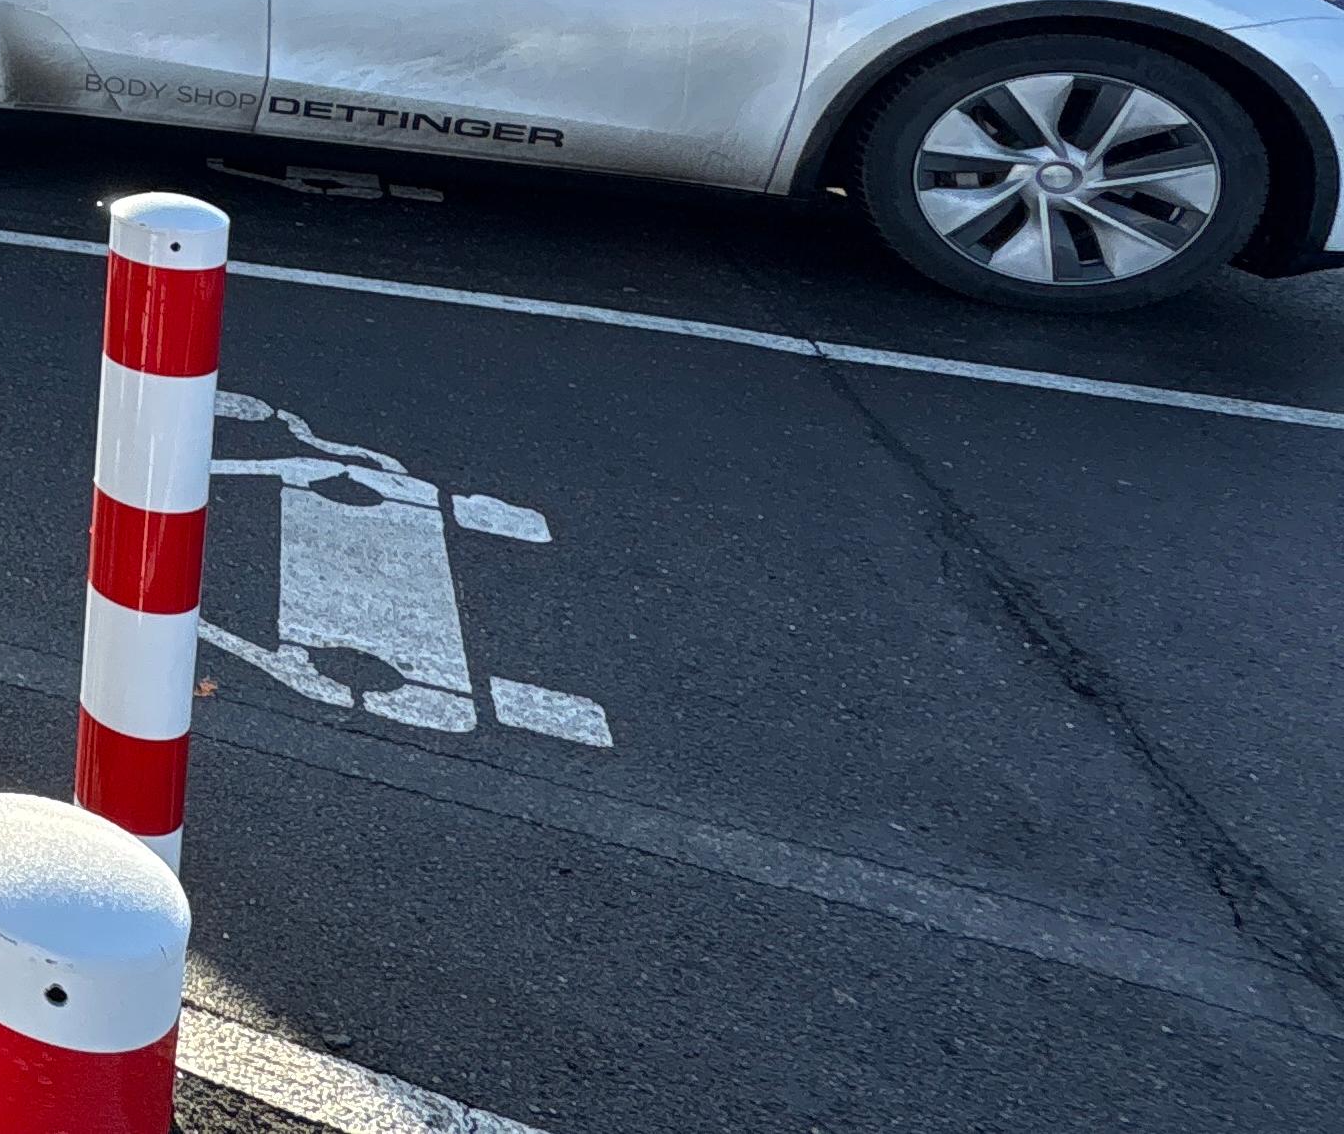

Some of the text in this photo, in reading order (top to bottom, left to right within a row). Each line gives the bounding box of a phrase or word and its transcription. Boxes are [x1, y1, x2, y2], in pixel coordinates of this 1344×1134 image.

[85, 73, 565, 148] BODY SHOP DETTINGER
